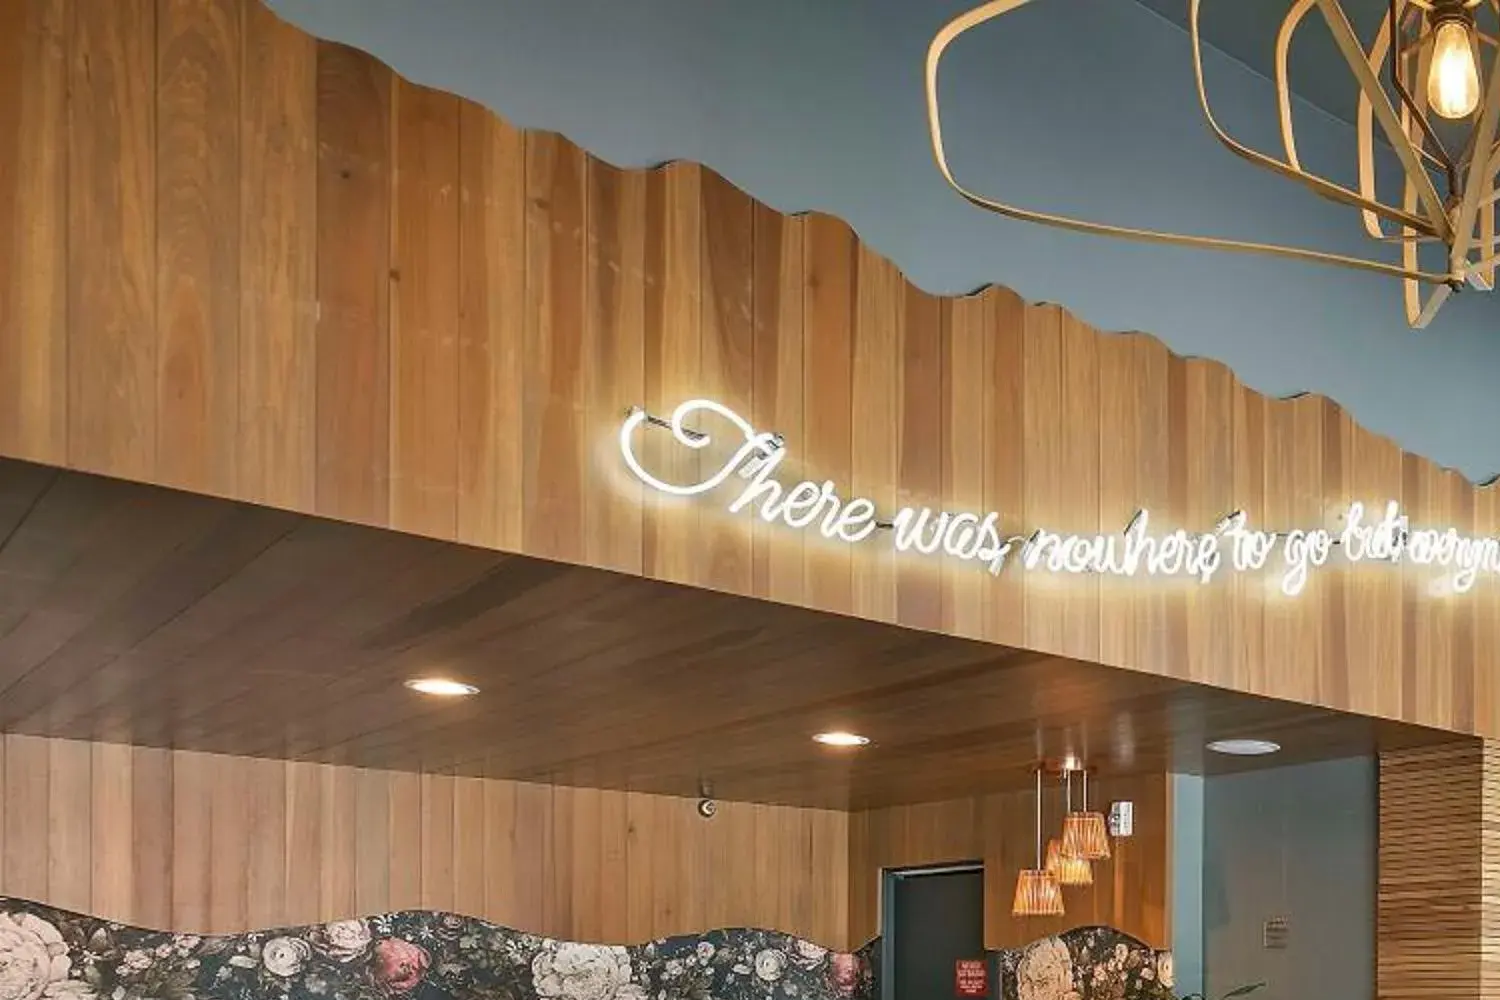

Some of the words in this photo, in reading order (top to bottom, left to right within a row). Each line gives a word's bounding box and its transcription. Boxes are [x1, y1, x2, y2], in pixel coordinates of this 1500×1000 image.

[619, 397, 877, 543] There
[893, 510, 1008, 576] was
[1021, 507, 1222, 584] nowhere
[1219, 508, 1276, 571] to
[1281, 529, 1333, 596] go
[1341, 499, 1408, 563] but
